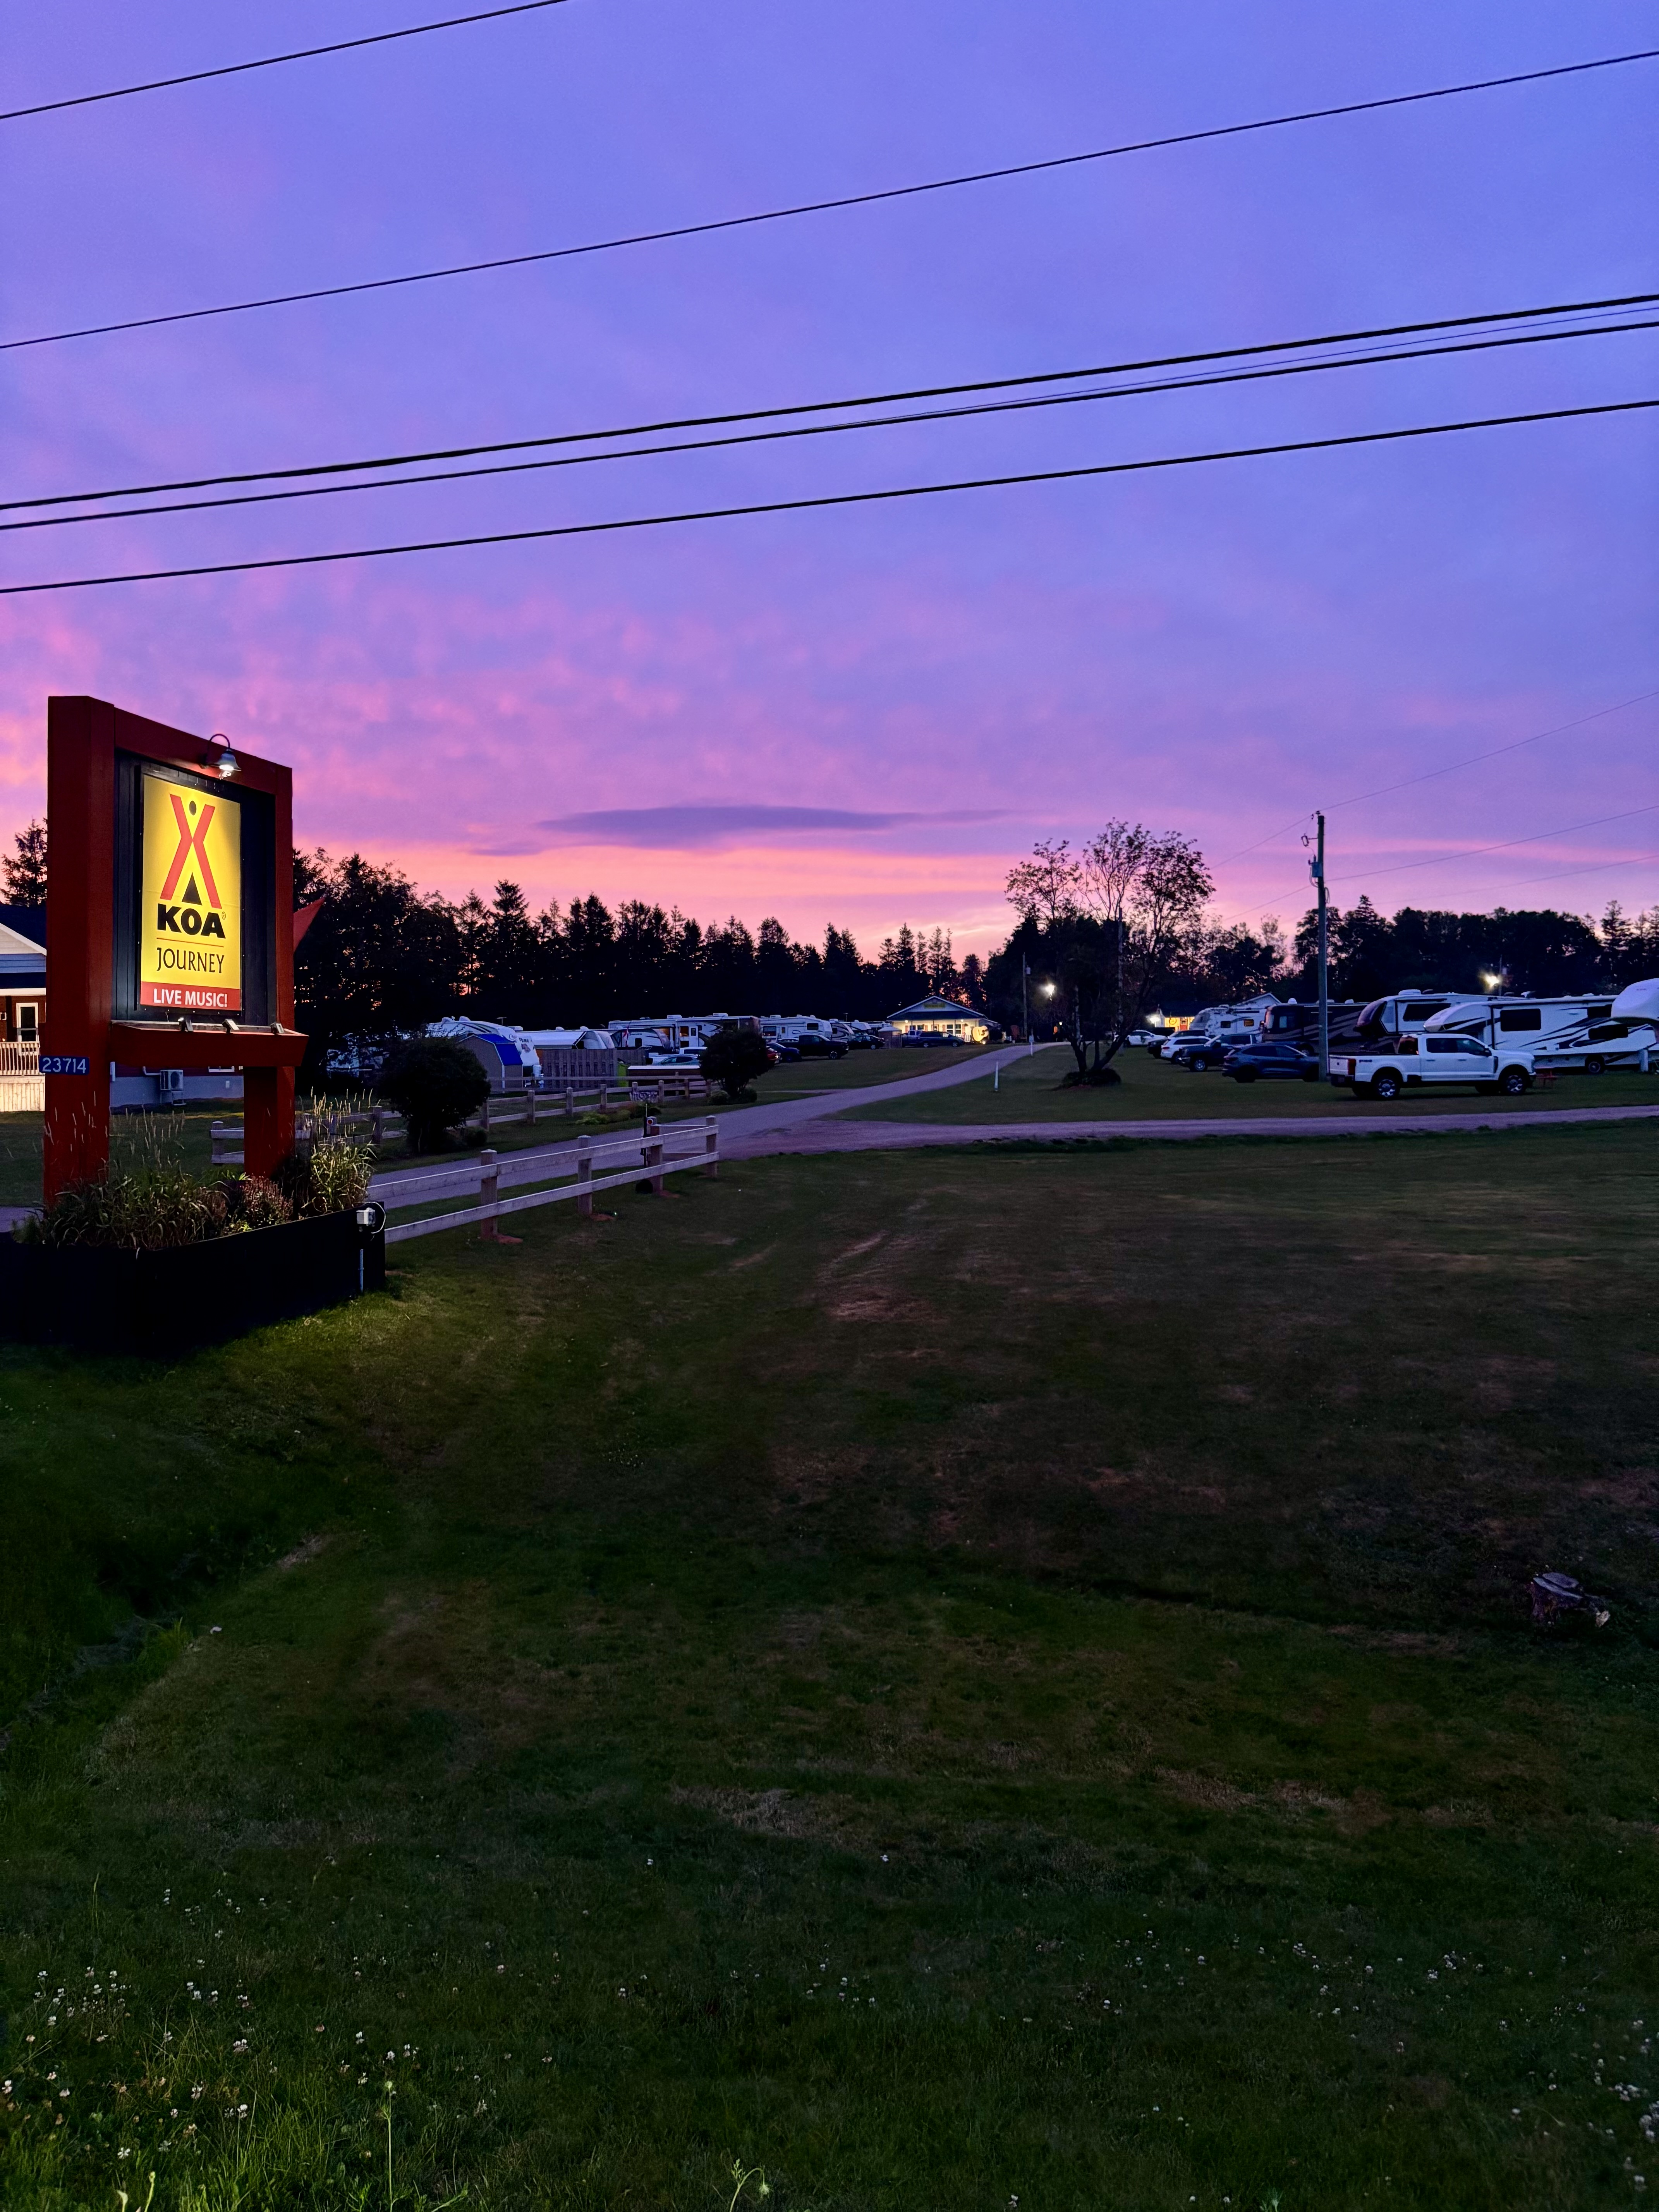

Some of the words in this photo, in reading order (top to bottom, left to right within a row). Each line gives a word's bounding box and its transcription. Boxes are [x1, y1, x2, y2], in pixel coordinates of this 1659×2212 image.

[157, 903, 226, 939] KOA
[156, 947, 225, 974] JOURNEY
[153, 988, 182, 1005] LIVE
[185, 991, 228, 1008] MUSIC!
[42, 1057, 86, 1074] 23714
